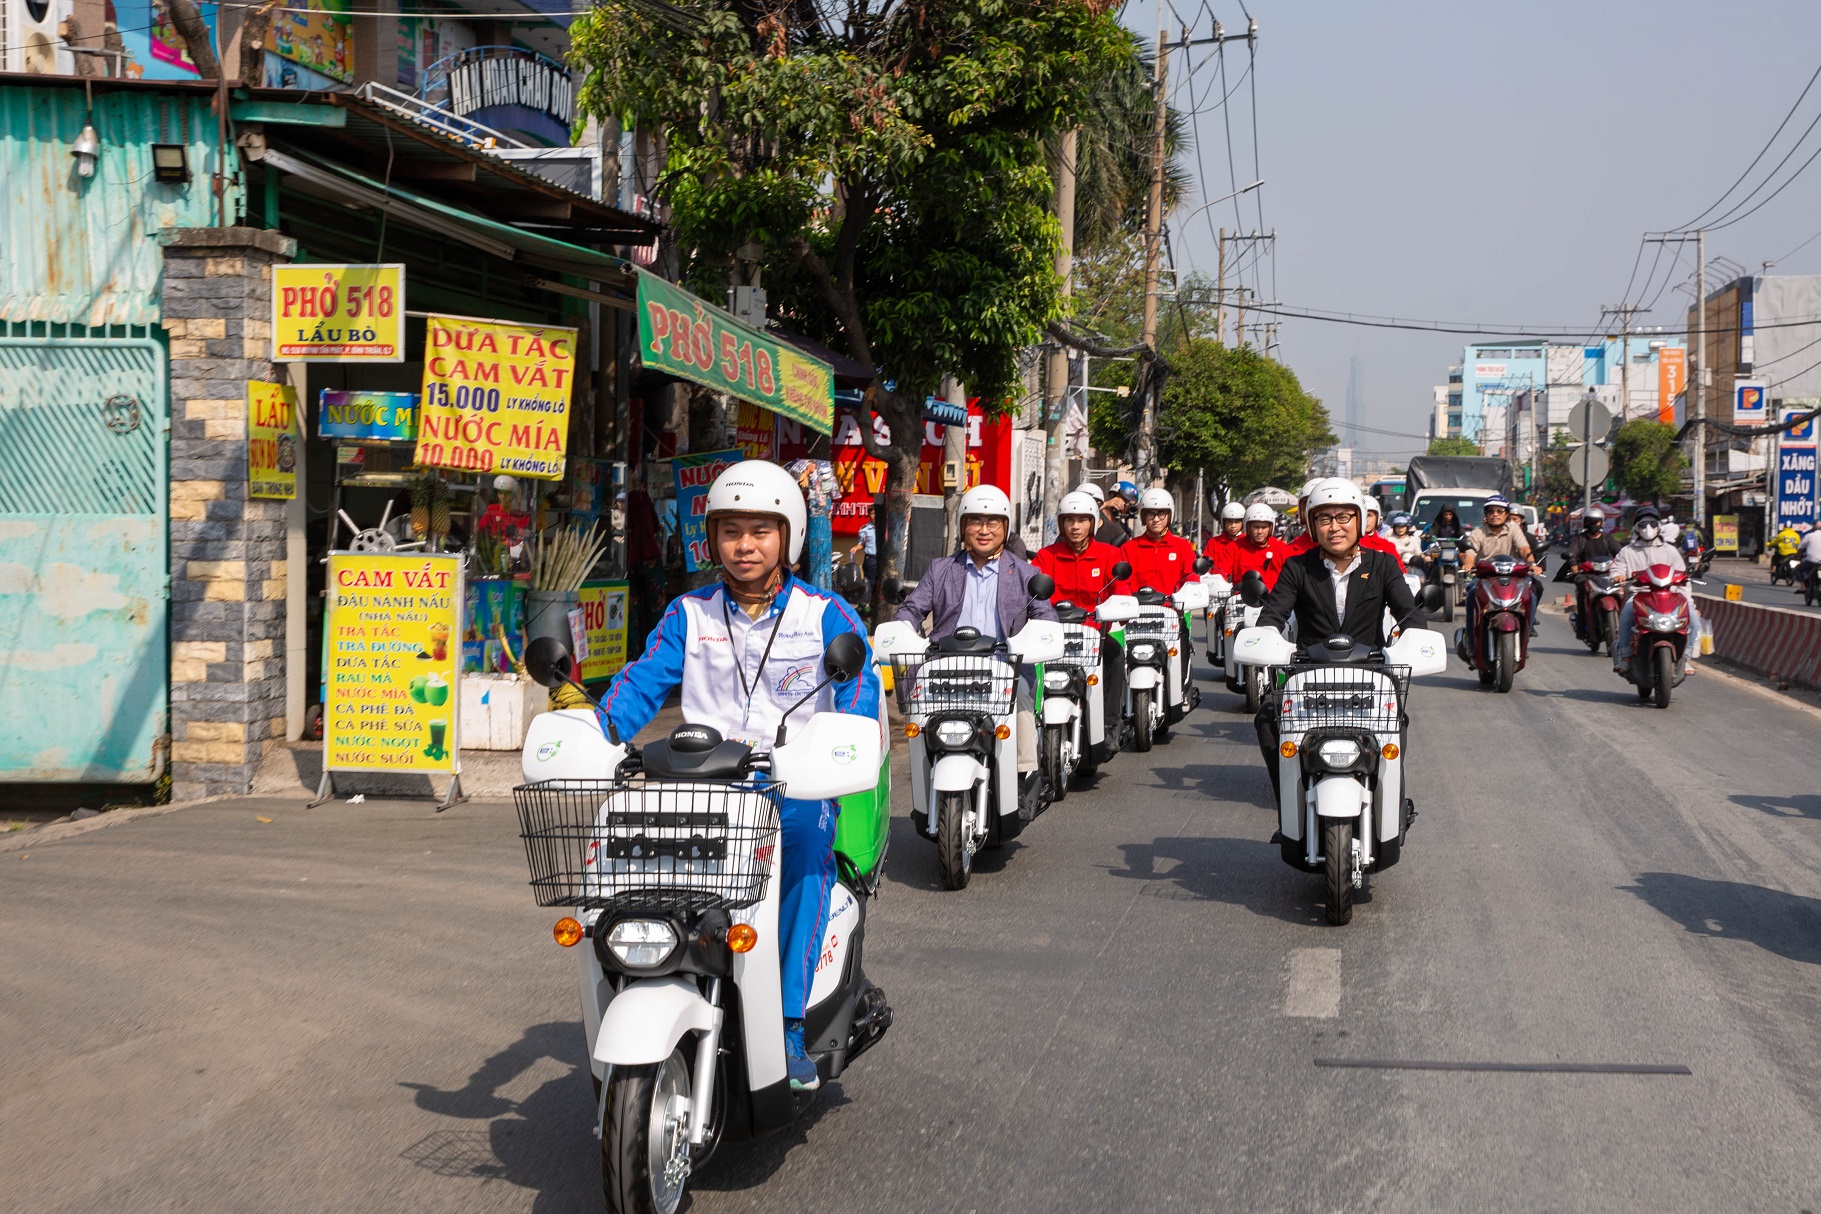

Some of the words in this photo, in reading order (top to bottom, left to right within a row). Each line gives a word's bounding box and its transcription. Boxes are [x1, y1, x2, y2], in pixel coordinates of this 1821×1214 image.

[481, 58, 518, 107] HOAN
[281, 272, 339, 318] PHỞ
[346, 285, 393, 318] 518
[347, 325, 377, 342] BÒ
[432, 324, 499, 353] DỪA
[507, 330, 570, 360] TẮC
[647, 300, 715, 372] PHỞ
[720, 330, 776, 396] 518
[428, 357, 500, 384] CAM
[509, 360, 570, 389] VẮT
[426, 382, 501, 413] 15.000
[506, 397, 518, 409] LY
[328, 400, 389, 426] NƯỚC
[422, 413, 503, 446] NƯỚC
[508, 420, 563, 452] MÍA
[779, 405, 863, 444] NÀ
[873, 415, 983, 446] SCH
[501, 457, 512, 470] LY
[1781, 452, 1815, 471] XĂNG
[862, 461, 933, 494] VN
[1780, 496, 1814, 516] NHỚT
[338, 569, 394, 588] CAM
[402, 562, 451, 588] VẮT
[336, 673, 366, 683] RAU
[371, 671, 393, 683] MÁ
[336, 686, 377, 699] NƯỚC
[381, 687, 408, 699] MÍA
[360, 702, 390, 715] PHÊ
[360, 718, 390, 731] PHÊ
[674, 731, 709, 740] HONDA
[335, 734, 376, 747] NƯỚC
[334, 750, 376, 764] NƯỚC
